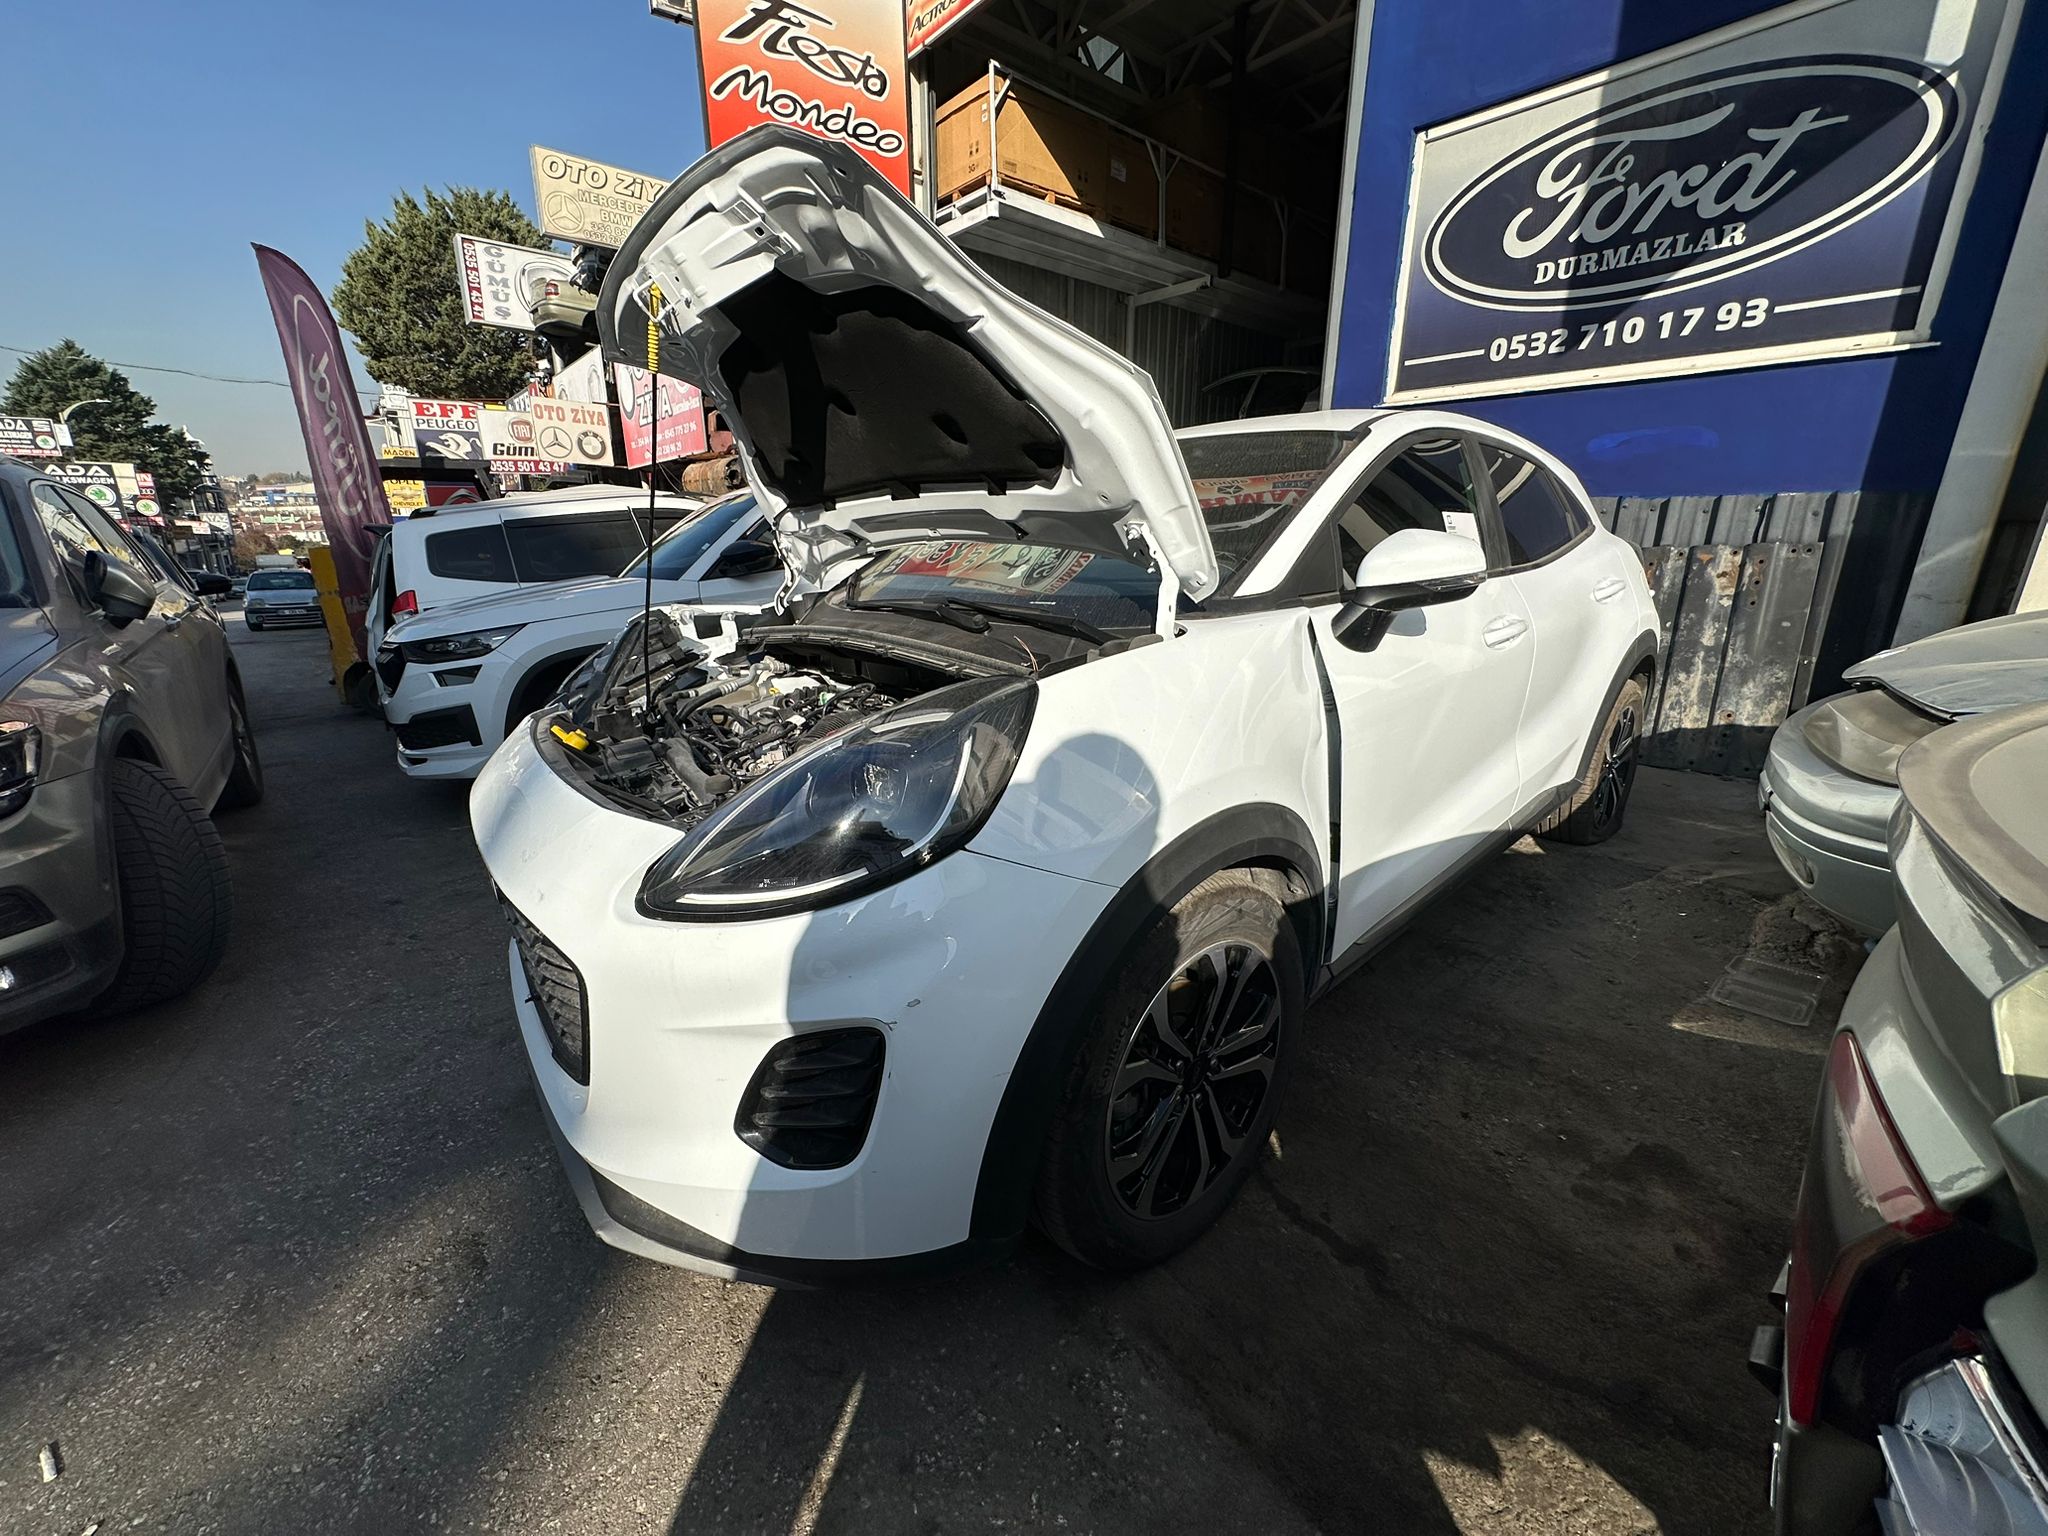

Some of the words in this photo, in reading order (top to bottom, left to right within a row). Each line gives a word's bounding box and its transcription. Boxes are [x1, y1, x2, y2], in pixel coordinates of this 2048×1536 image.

[910, 0, 958, 38] ACTRO
[721, 0, 891, 100] Fiesta
[711, 67, 905, 155] Mondeo
[542, 155, 608, 190] OTO
[1503, 102, 1849, 260] Ford
[600, 208, 633, 228] BMW
[462, 241, 478, 269] 0535
[1533, 221, 1747, 286] DURMAZLAR
[467, 270, 481, 288] 501
[470, 289, 483, 304] 43
[473, 304, 485, 320] 47
[1489, 328, 1570, 362] 0532
[1576, 316, 1647, 351] 710
[1658, 307, 1706, 339] 17
[1714, 297, 1771, 332] 93
[533, 403, 567, 422] OTO
[570, 406, 607, 427] ZİYA
[636, 384, 674, 428] ZİA
[416, 418, 478, 430] PEUGEO
[513, 424, 531, 439] FIAT
[383, 448, 416, 458] MADEN
[492, 442, 539, 457] Güm
[44, 463, 110, 477] ADA
[490, 460, 516, 472] 0535
[518, 461, 536, 472] 501
[538, 461, 551, 472] 43
[552, 462, 566, 473] 47
